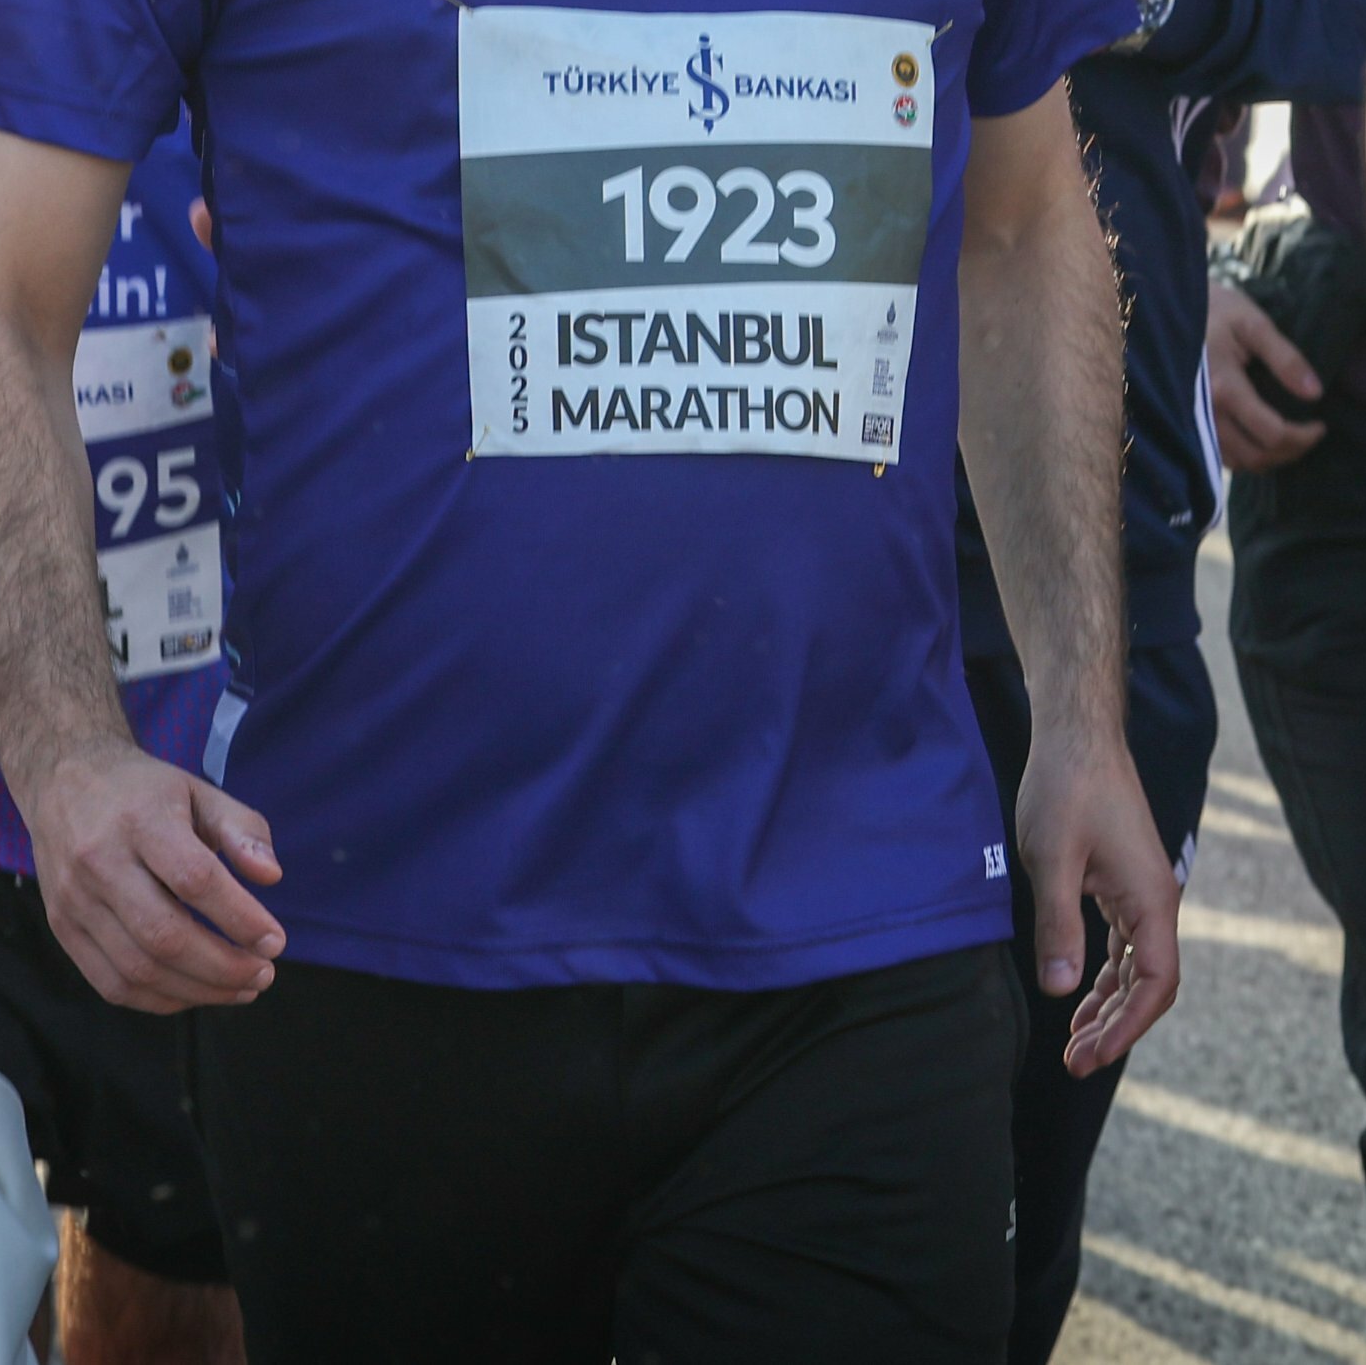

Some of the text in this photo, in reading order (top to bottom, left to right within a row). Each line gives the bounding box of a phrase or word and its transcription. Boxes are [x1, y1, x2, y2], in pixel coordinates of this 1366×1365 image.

[543, 65, 680, 95] TÜRKİYE
[735, 76, 857, 104] BANKASI
[602, 165, 836, 268] 1923
[557, 310, 838, 371] ISTANBUL
[508, 312, 529, 433] 2025
[551, 384, 840, 437] MARATHON
